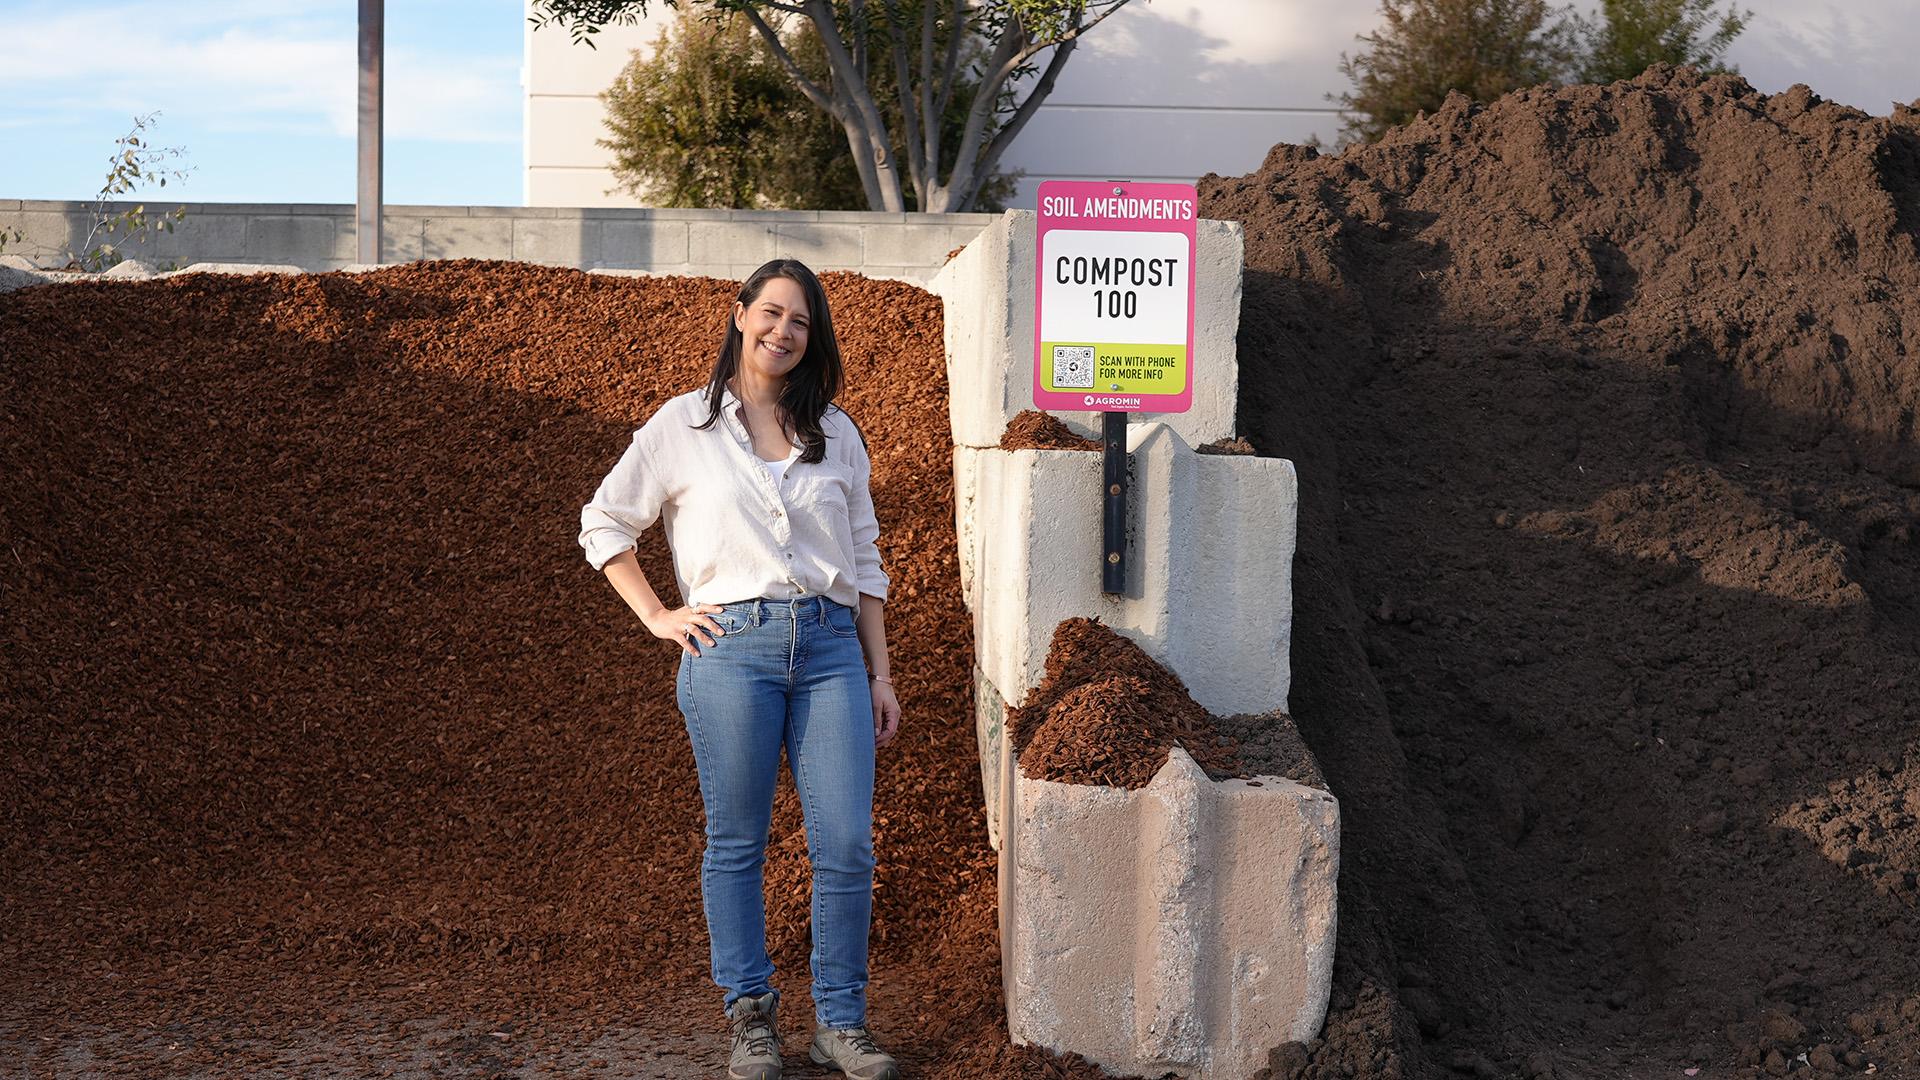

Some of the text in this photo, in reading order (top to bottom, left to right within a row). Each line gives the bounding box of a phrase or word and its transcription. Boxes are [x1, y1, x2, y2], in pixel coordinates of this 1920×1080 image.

[1043, 196, 1192, 220] SOIL AMENDMENTS
[1056, 256, 1178, 287] COMPOST
[1094, 290, 1137, 319] 100
[1099, 355, 1176, 368] SCAN WITH PHONE
[1099, 368, 1163, 380] FOR MORE INFO
[1095, 397, 1140, 405] AGROMIN
